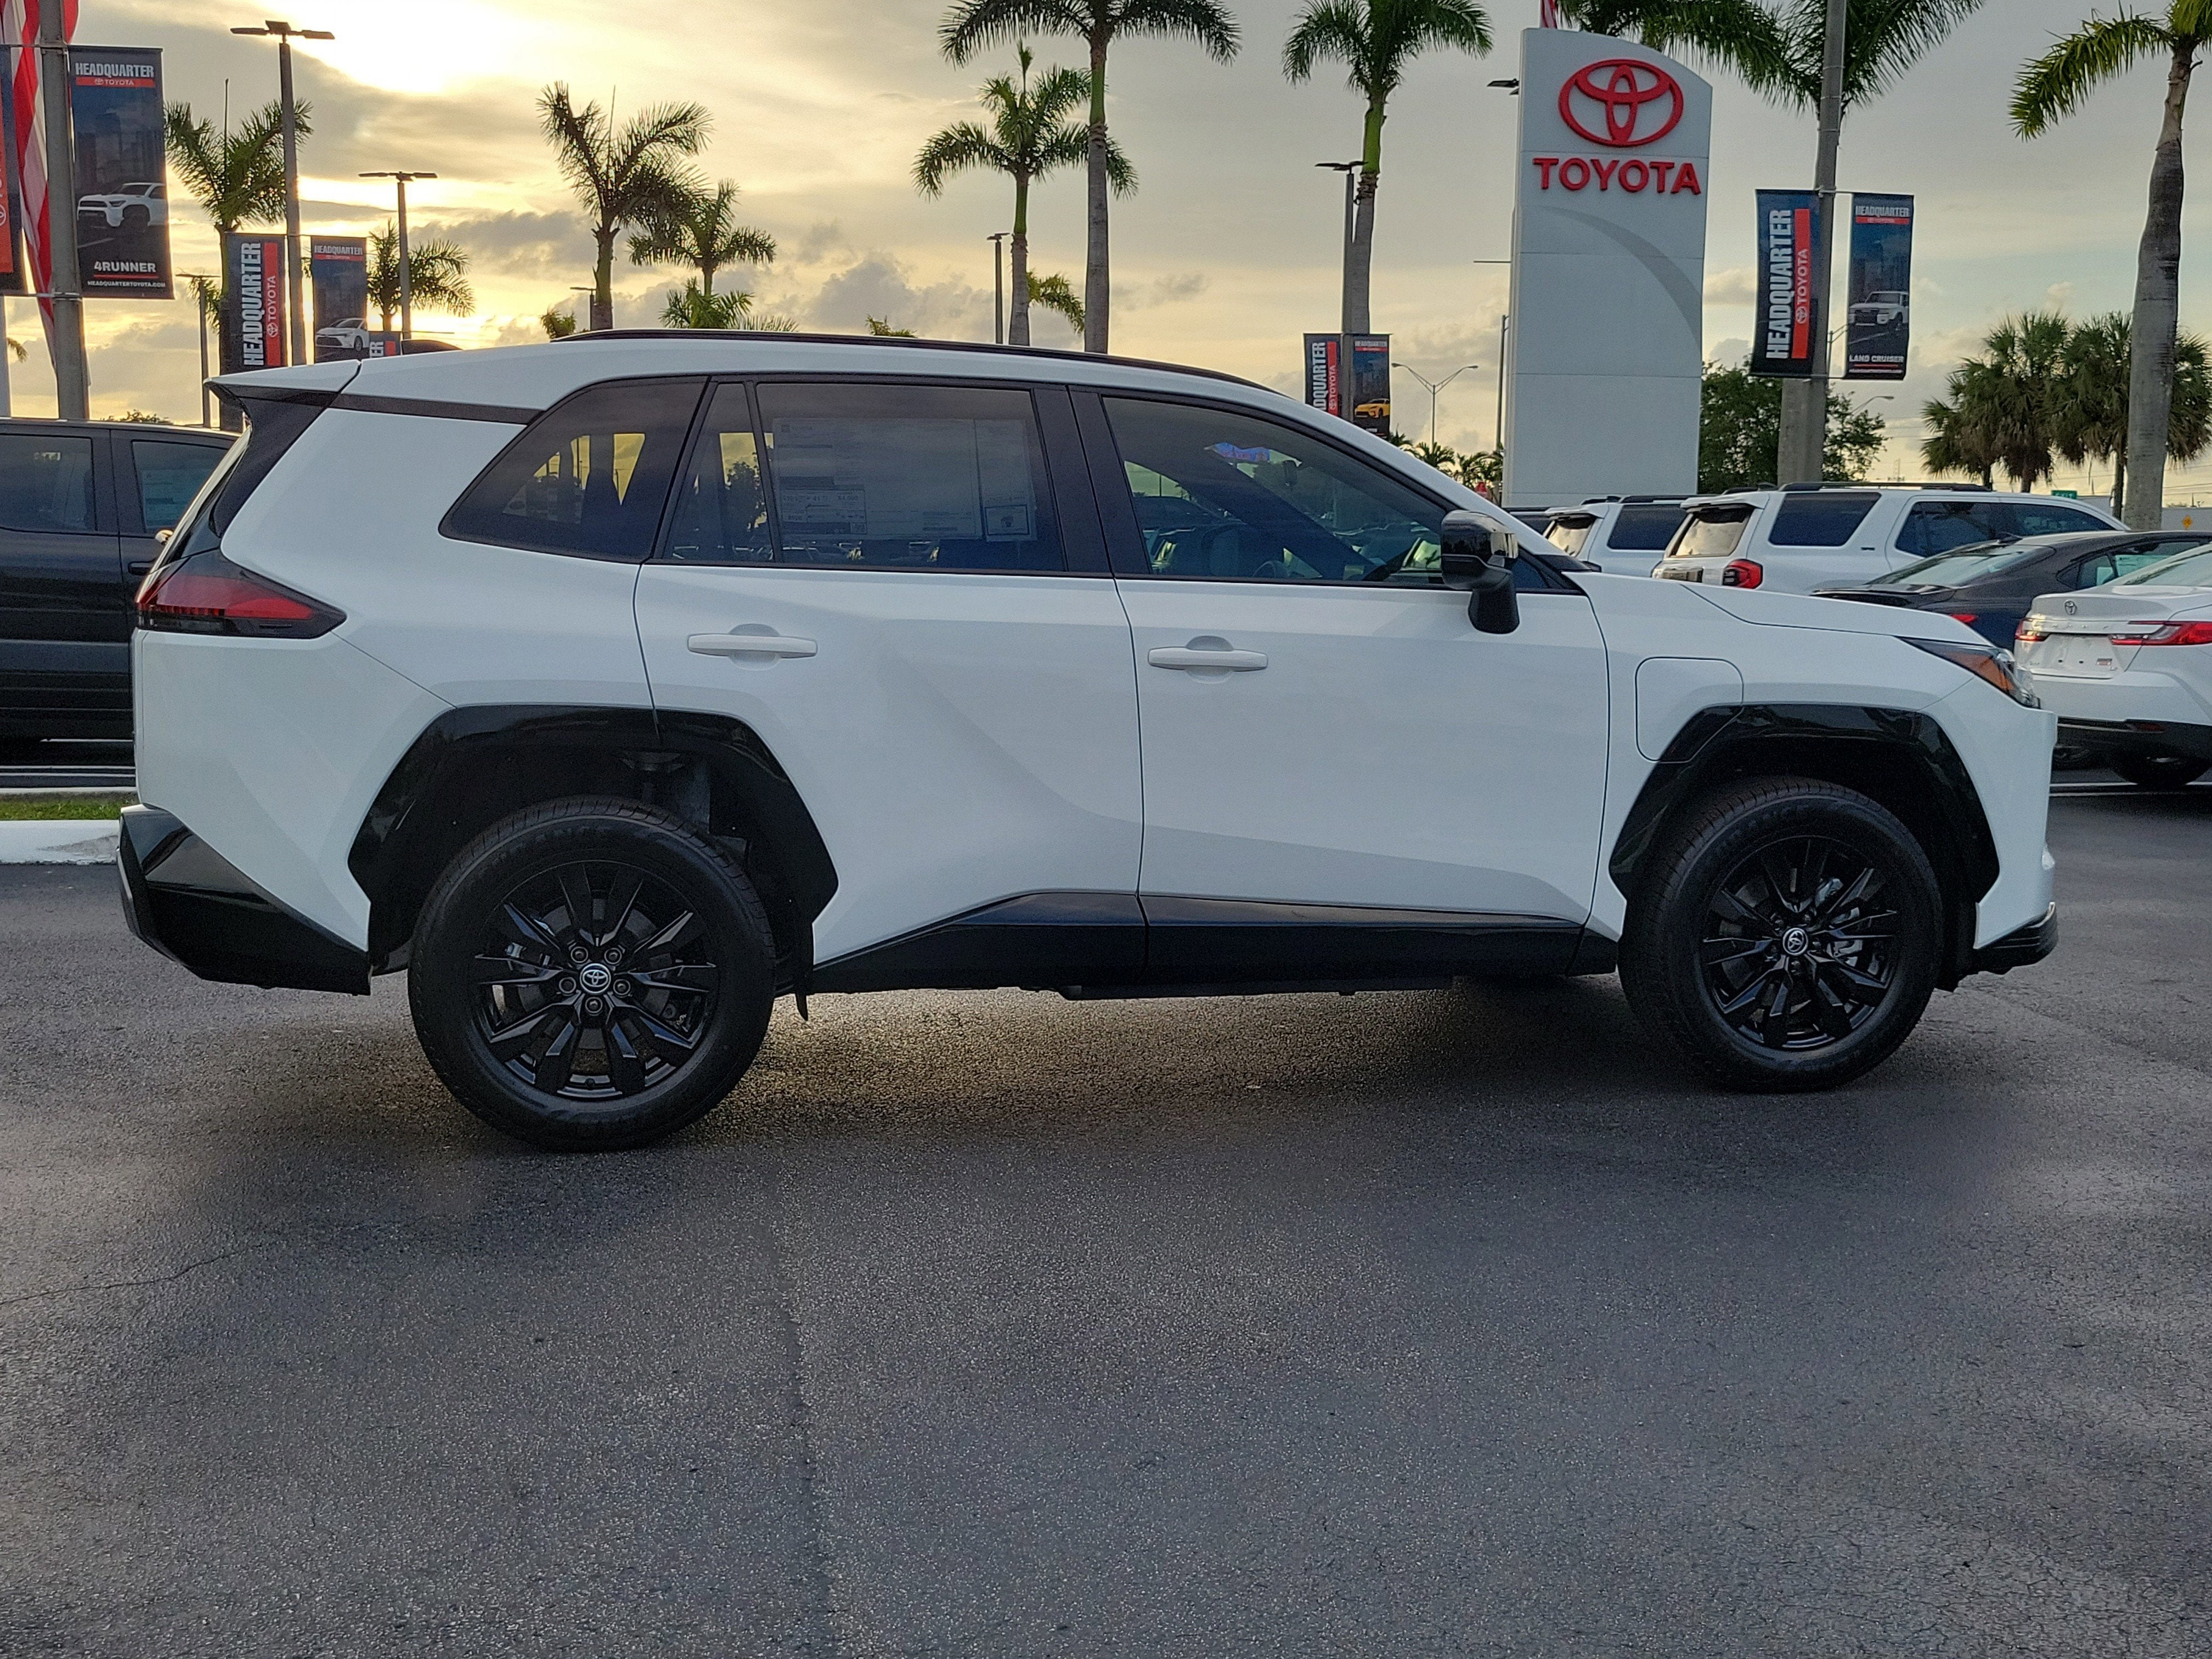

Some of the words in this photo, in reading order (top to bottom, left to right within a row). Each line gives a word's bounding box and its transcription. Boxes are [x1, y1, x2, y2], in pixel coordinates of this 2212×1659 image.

[75, 63, 154, 78] HEADQUARTER
[1533, 157, 1701, 194] TOYOTA
[94, 261, 156, 272] 4RUNNER
[314, 245, 363, 256] HEADQUARTER
[1766, 210, 1794, 359] HEADQUARTER
[1797, 249, 1808, 304] TOYOTA
[241, 242, 264, 365] HEADQUARTER
[267, 275, 278, 322] TOYOTA
[370, 341, 383, 358] ER
